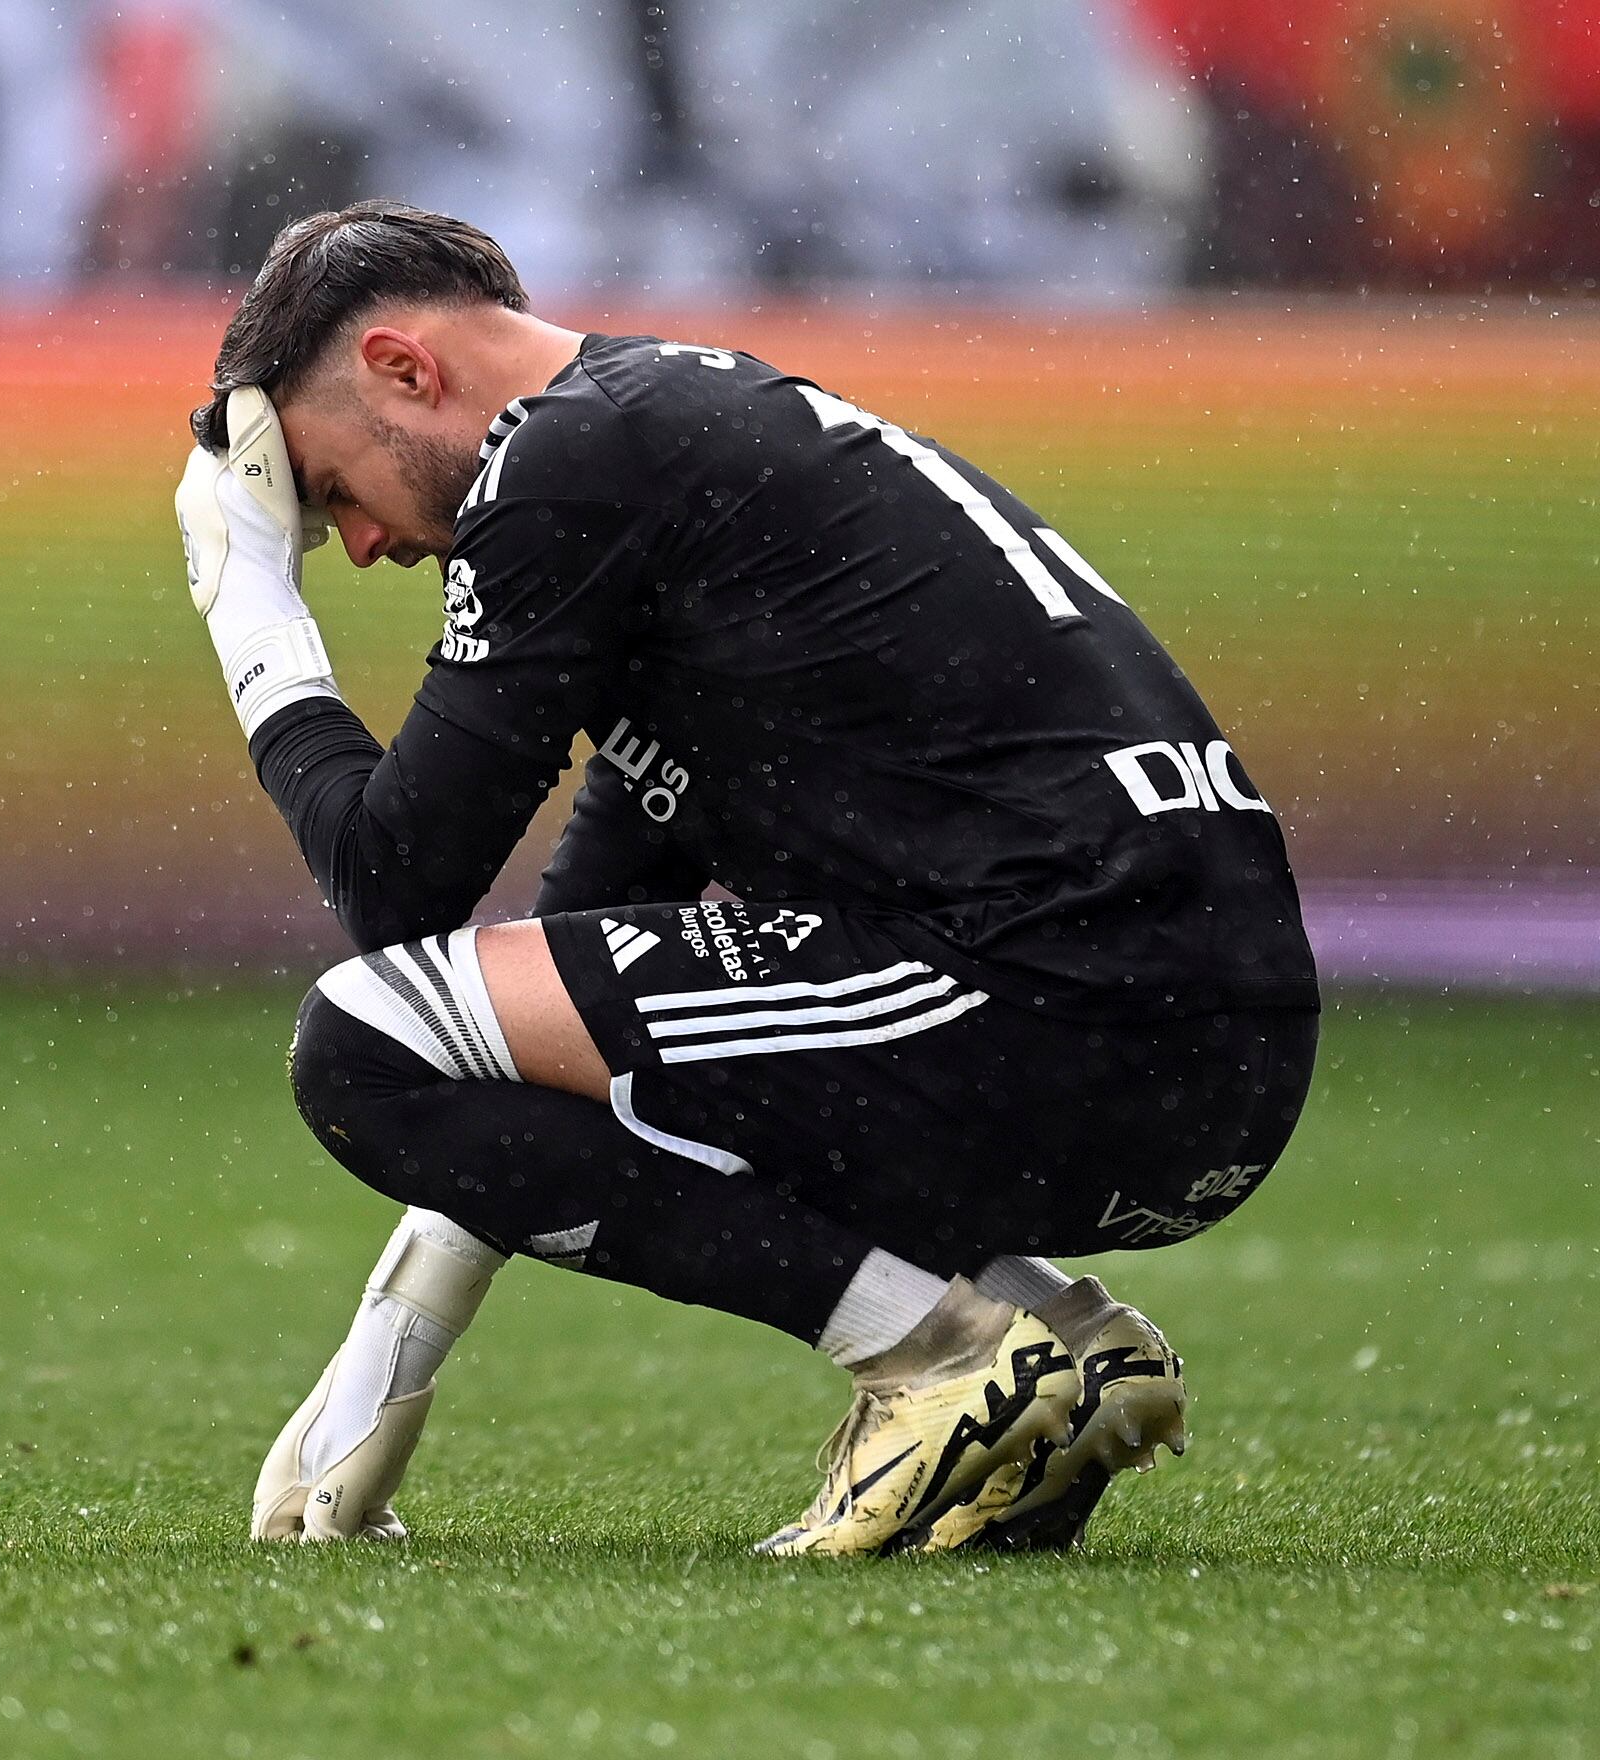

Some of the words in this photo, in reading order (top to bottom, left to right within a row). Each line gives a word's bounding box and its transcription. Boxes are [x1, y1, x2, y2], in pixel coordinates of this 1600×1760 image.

[659, 342, 736, 370] J
[678, 907, 710, 958] Burgos
[699, 901, 748, 981] ecoletas
